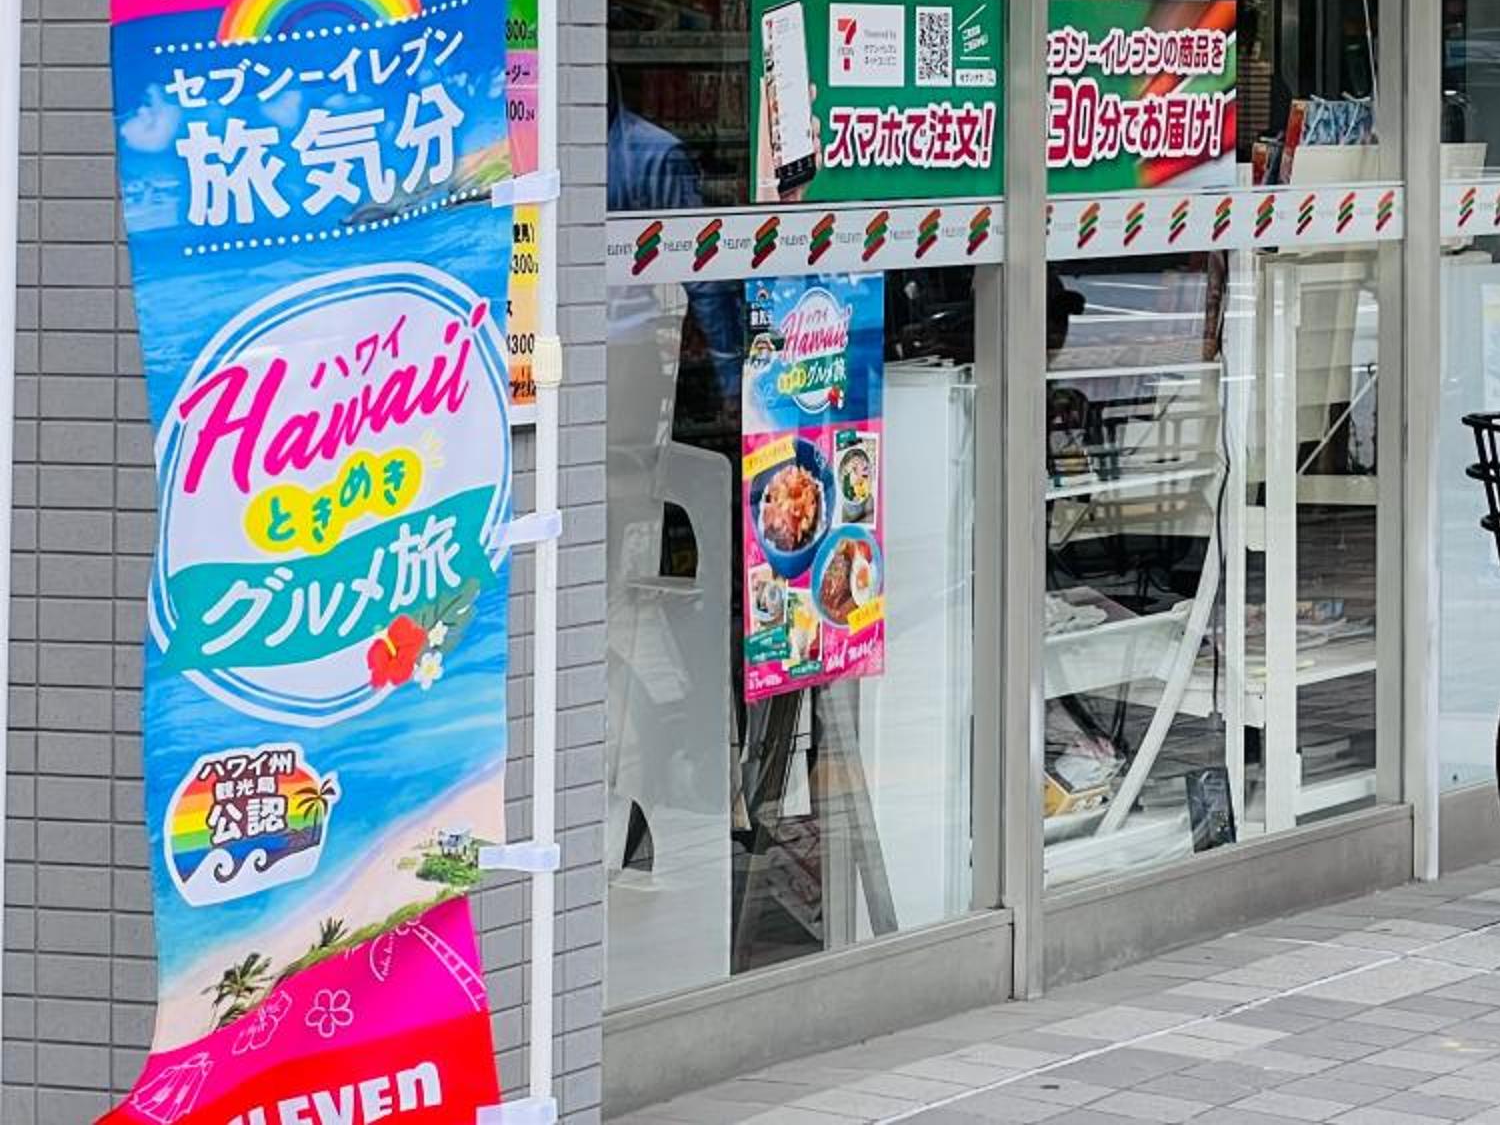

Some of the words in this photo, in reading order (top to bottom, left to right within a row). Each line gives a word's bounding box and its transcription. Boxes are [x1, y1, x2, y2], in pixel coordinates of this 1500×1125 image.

[176, 85, 465, 227] 旅気分
[309, 315, 407, 389] ハワイ
[179, 302, 488, 494] Hawaii
[267, 459, 406, 544] ときめき
[202, 515, 463, 655] グルメ旅
[200, 751, 293, 780] ハワイ州
[208, 797, 286, 844] 公認
